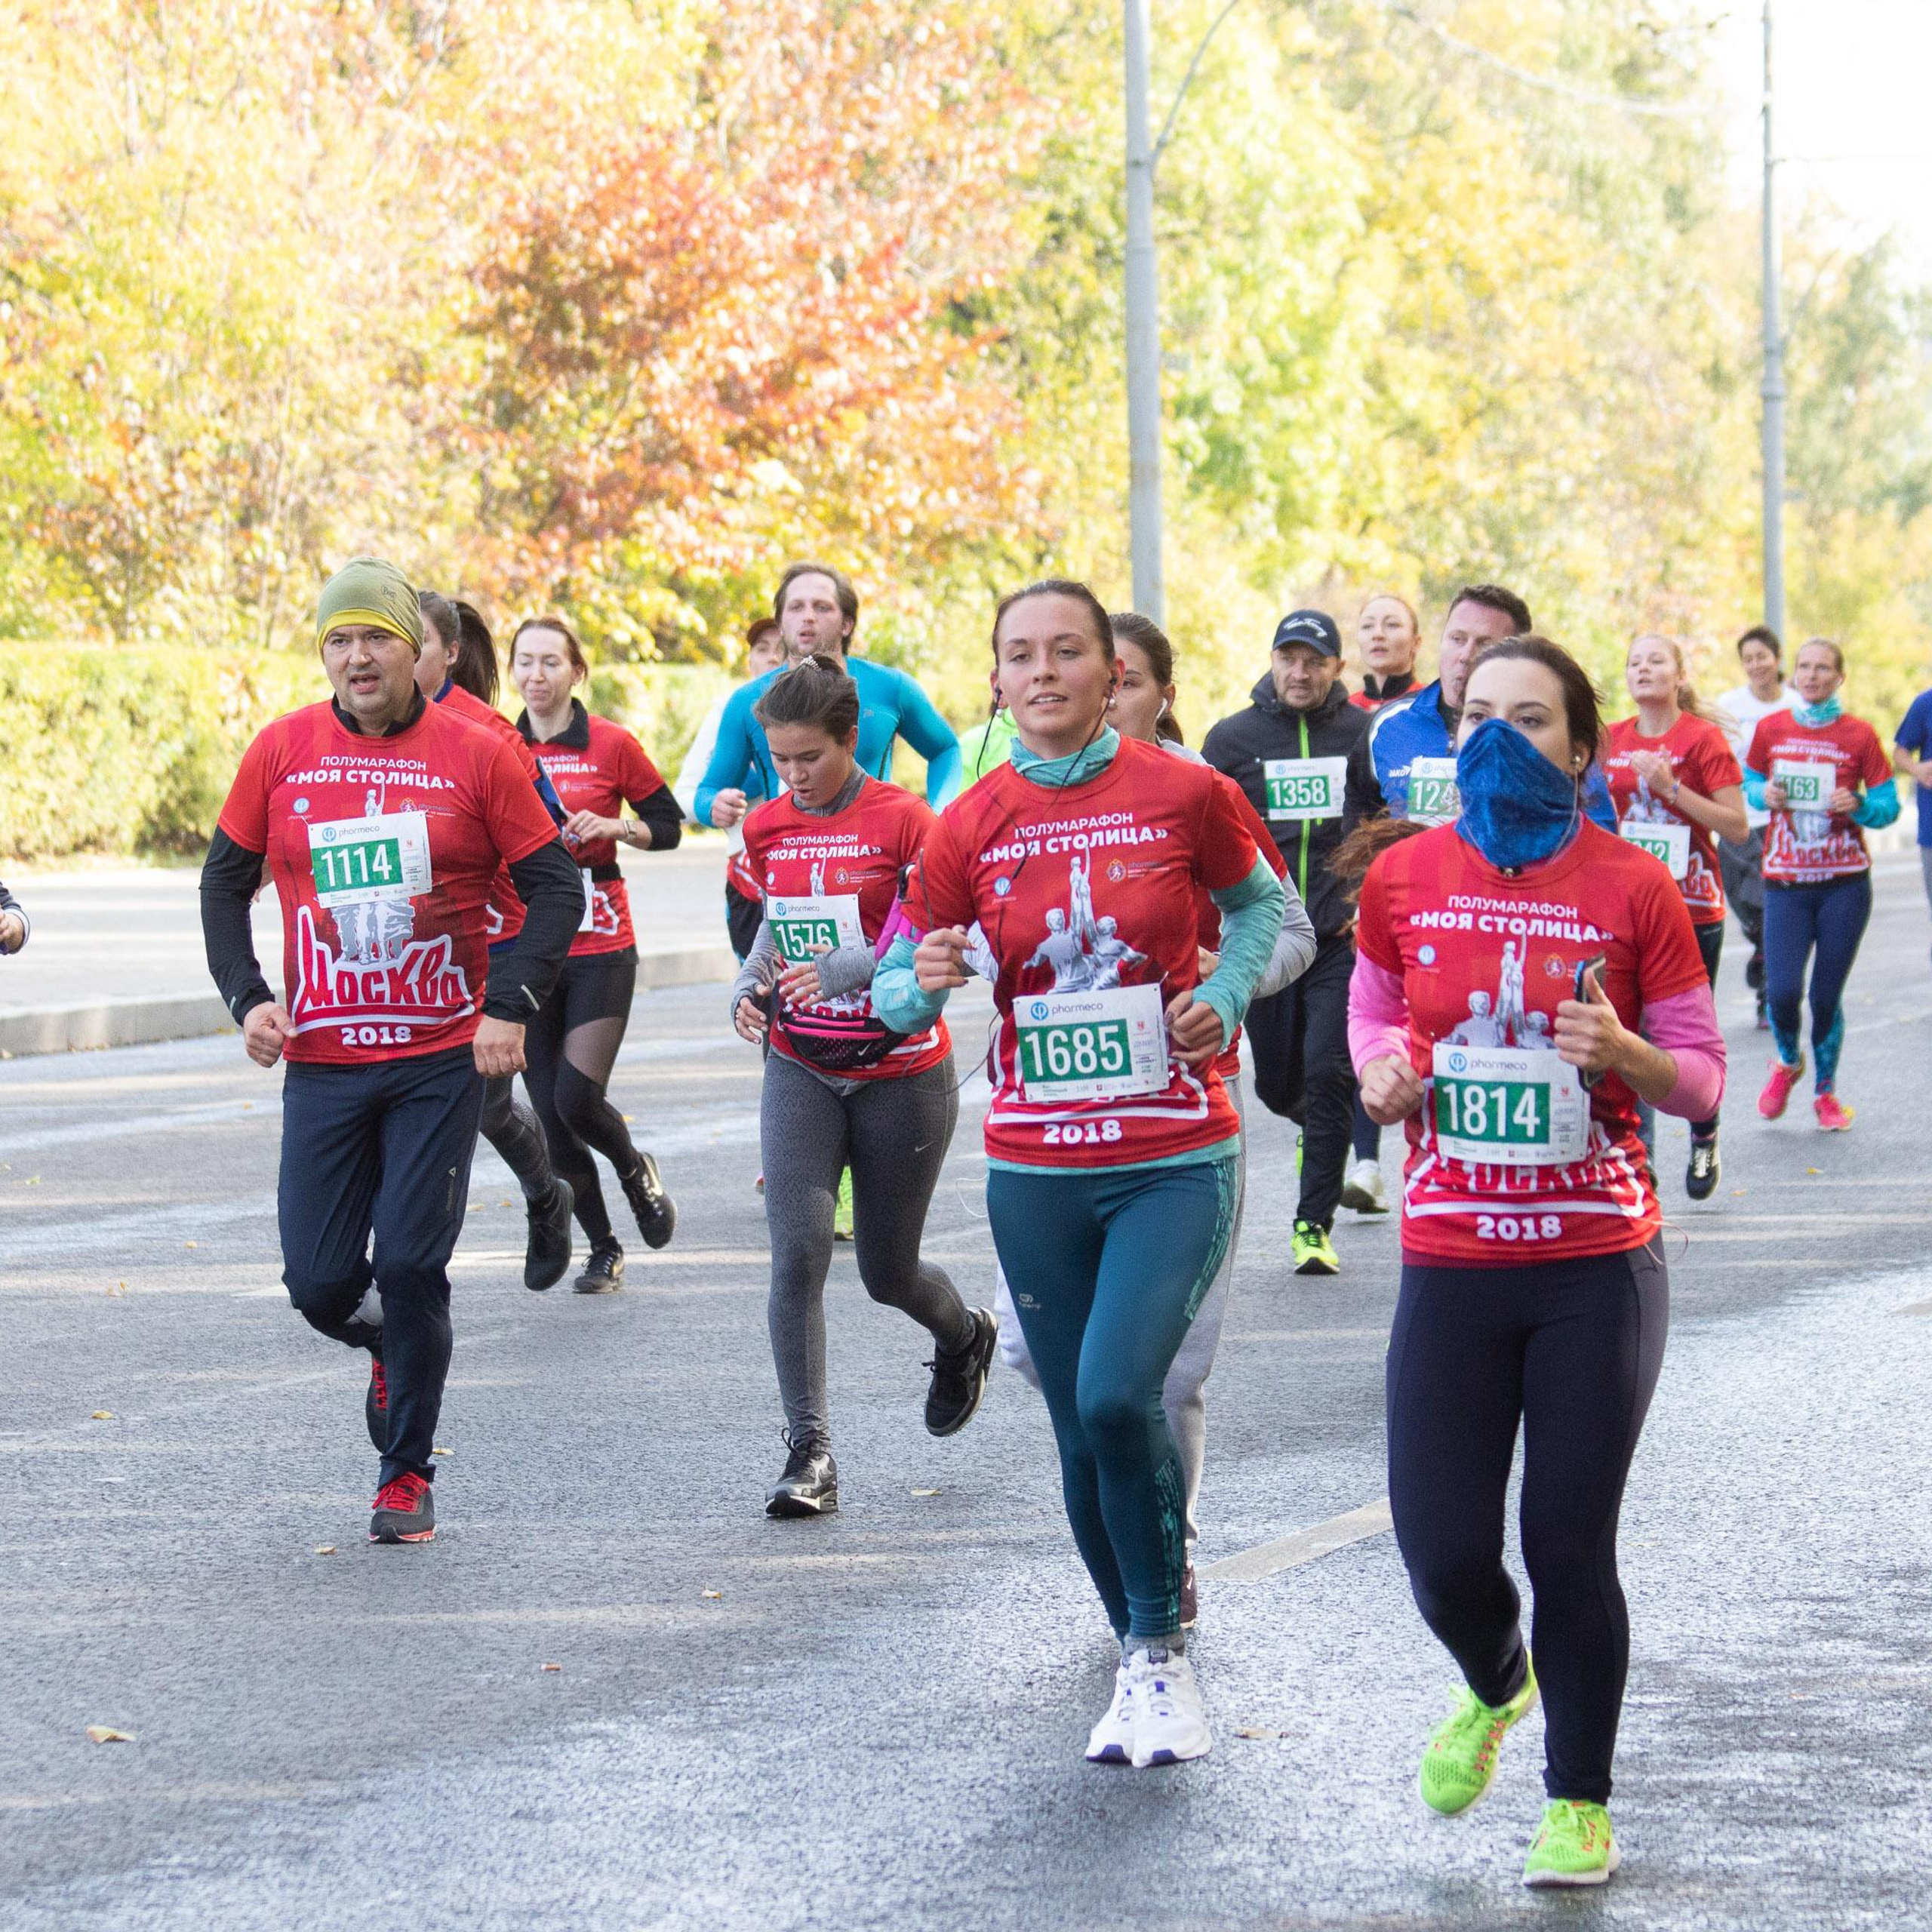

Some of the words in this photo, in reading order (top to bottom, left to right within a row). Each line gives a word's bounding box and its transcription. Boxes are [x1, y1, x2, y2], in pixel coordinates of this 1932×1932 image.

[321, 756, 426, 771] ПОЛУМАРАФОН
[286, 769, 341, 784] «МОЯ
[346, 770, 455, 789] СТОЛИЦА»
[1272, 778, 1326, 807] 1358
[1414, 780, 1460, 813] 124
[339, 825, 380, 838] pharmeco
[1015, 813, 1133, 839] ПОЛУМАРАФОН
[783, 834, 858, 847] ПОЛУМАРАФОН
[800, 844, 882, 860] СТОЛИЦА»
[980, 841, 1041, 863] «МОЯ
[1046, 826, 1168, 854] СТОЛИЦА»
[321, 844, 392, 888] 1114
[1447, 895, 1578, 918] ПОЛУМАРАФОН
[776, 922, 834, 958] 1576
[1410, 912, 1472, 930] «МОЯ
[1478, 915, 1614, 943] СТОЛИЦА»
[1051, 1001, 1103, 1015] pharmeco
[341, 1026, 411, 1045] 2018
[1025, 1025, 1123, 1077] 1685
[1471, 1058, 1527, 1071] pharmeco
[1442, 1083, 1541, 1138] 1814
[1043, 1119, 1123, 1144] 2018
[1476, 1215, 1563, 1241] 2018
